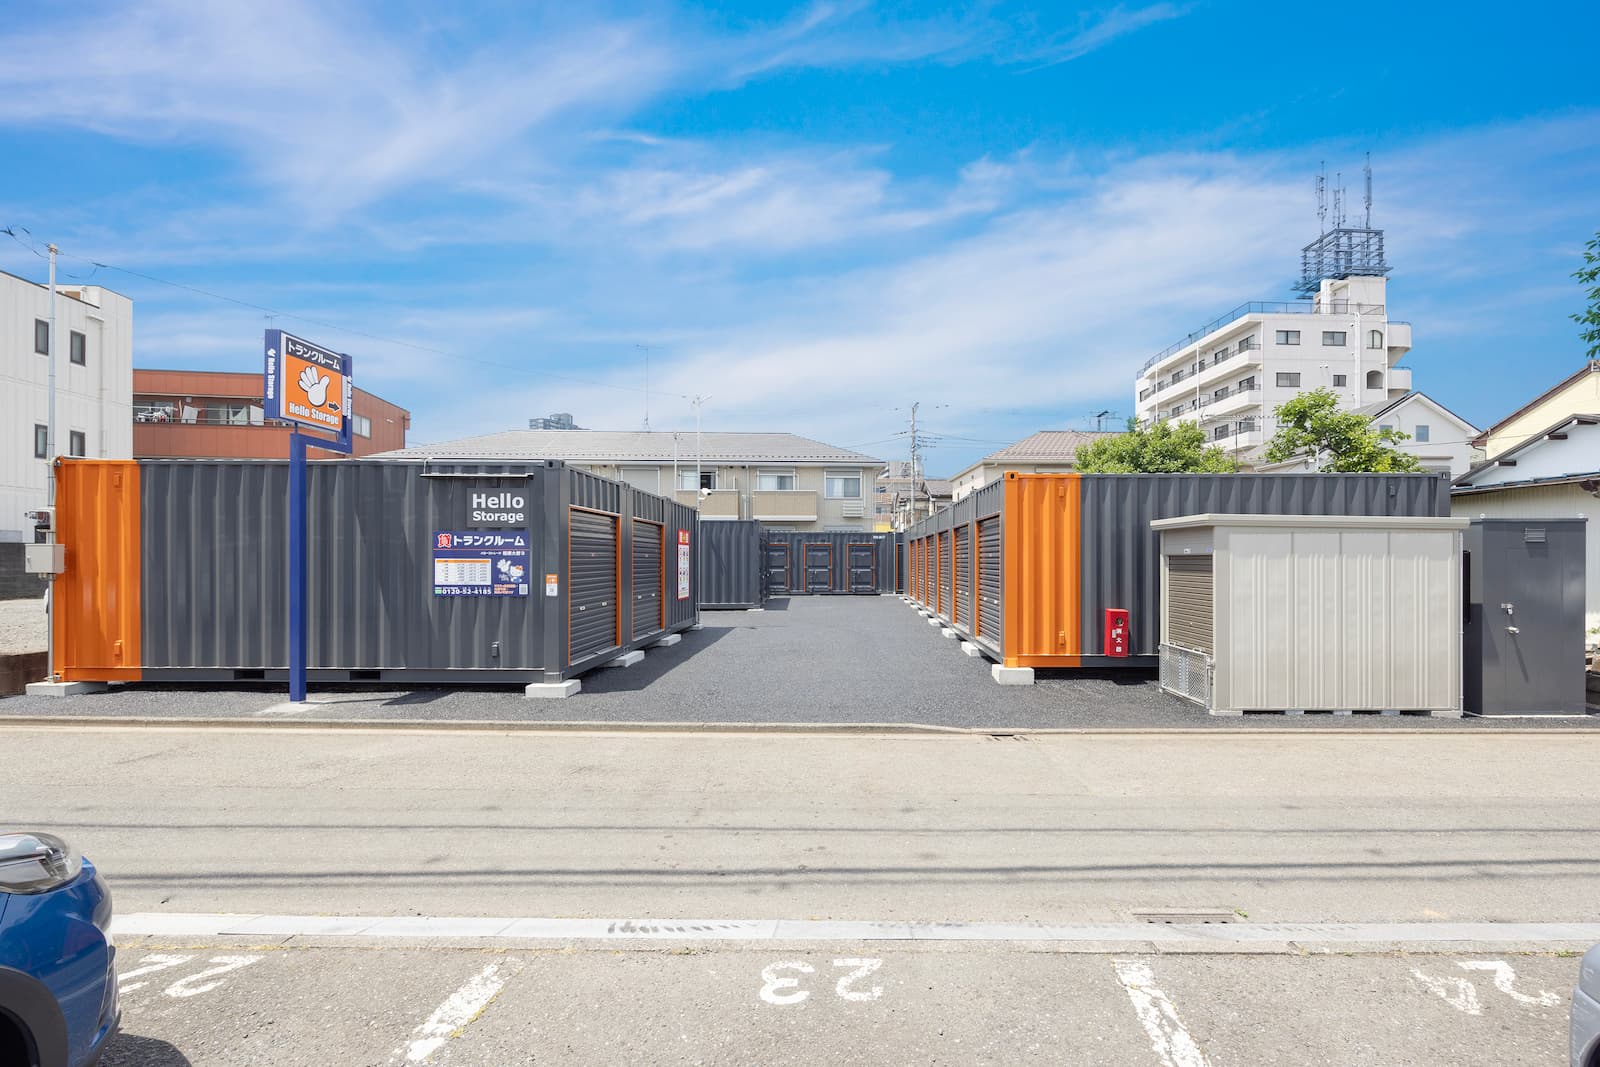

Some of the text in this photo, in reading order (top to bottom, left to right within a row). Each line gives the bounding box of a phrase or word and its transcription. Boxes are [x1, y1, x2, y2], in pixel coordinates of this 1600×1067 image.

[288, 341, 340, 370] トランクルーム
[289, 402, 339, 424] Hello Storage
[472, 493, 524, 509] Hello
[472, 510, 524, 523] Storage
[453, 535, 525, 546] トランクルーム
[760, 958, 883, 1005] 23
